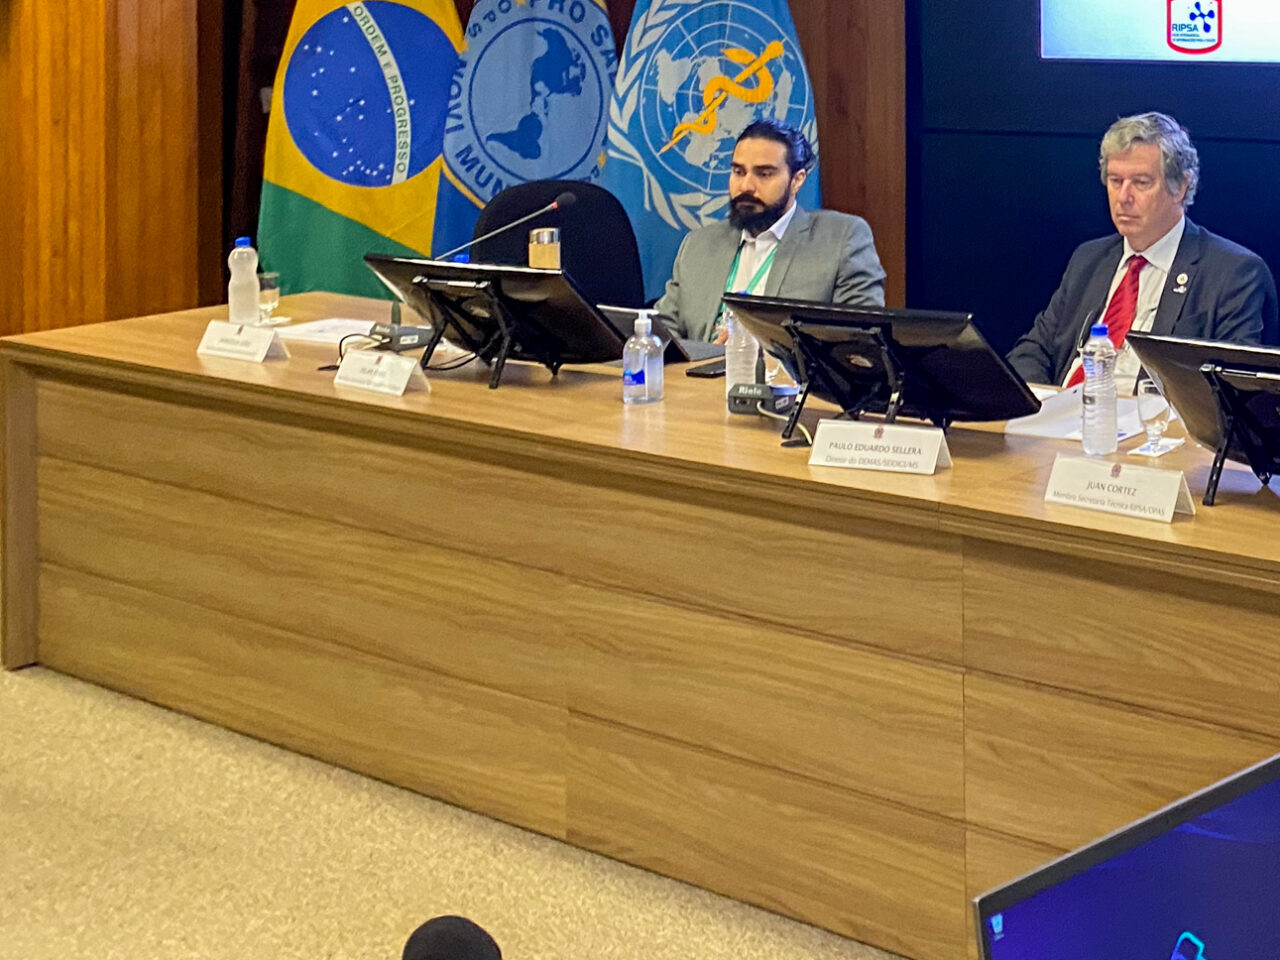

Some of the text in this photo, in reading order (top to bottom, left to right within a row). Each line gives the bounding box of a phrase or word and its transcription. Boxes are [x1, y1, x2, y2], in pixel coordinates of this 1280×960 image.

[1172, 24, 1198, 32] RIPSA
[353, 6, 409, 174] ORDEM E PROGRESSO
[828, 442, 922, 456] PAULO EDUARDO SELLERA
[1086, 480, 1137, 496] JUAN CORTEZ
